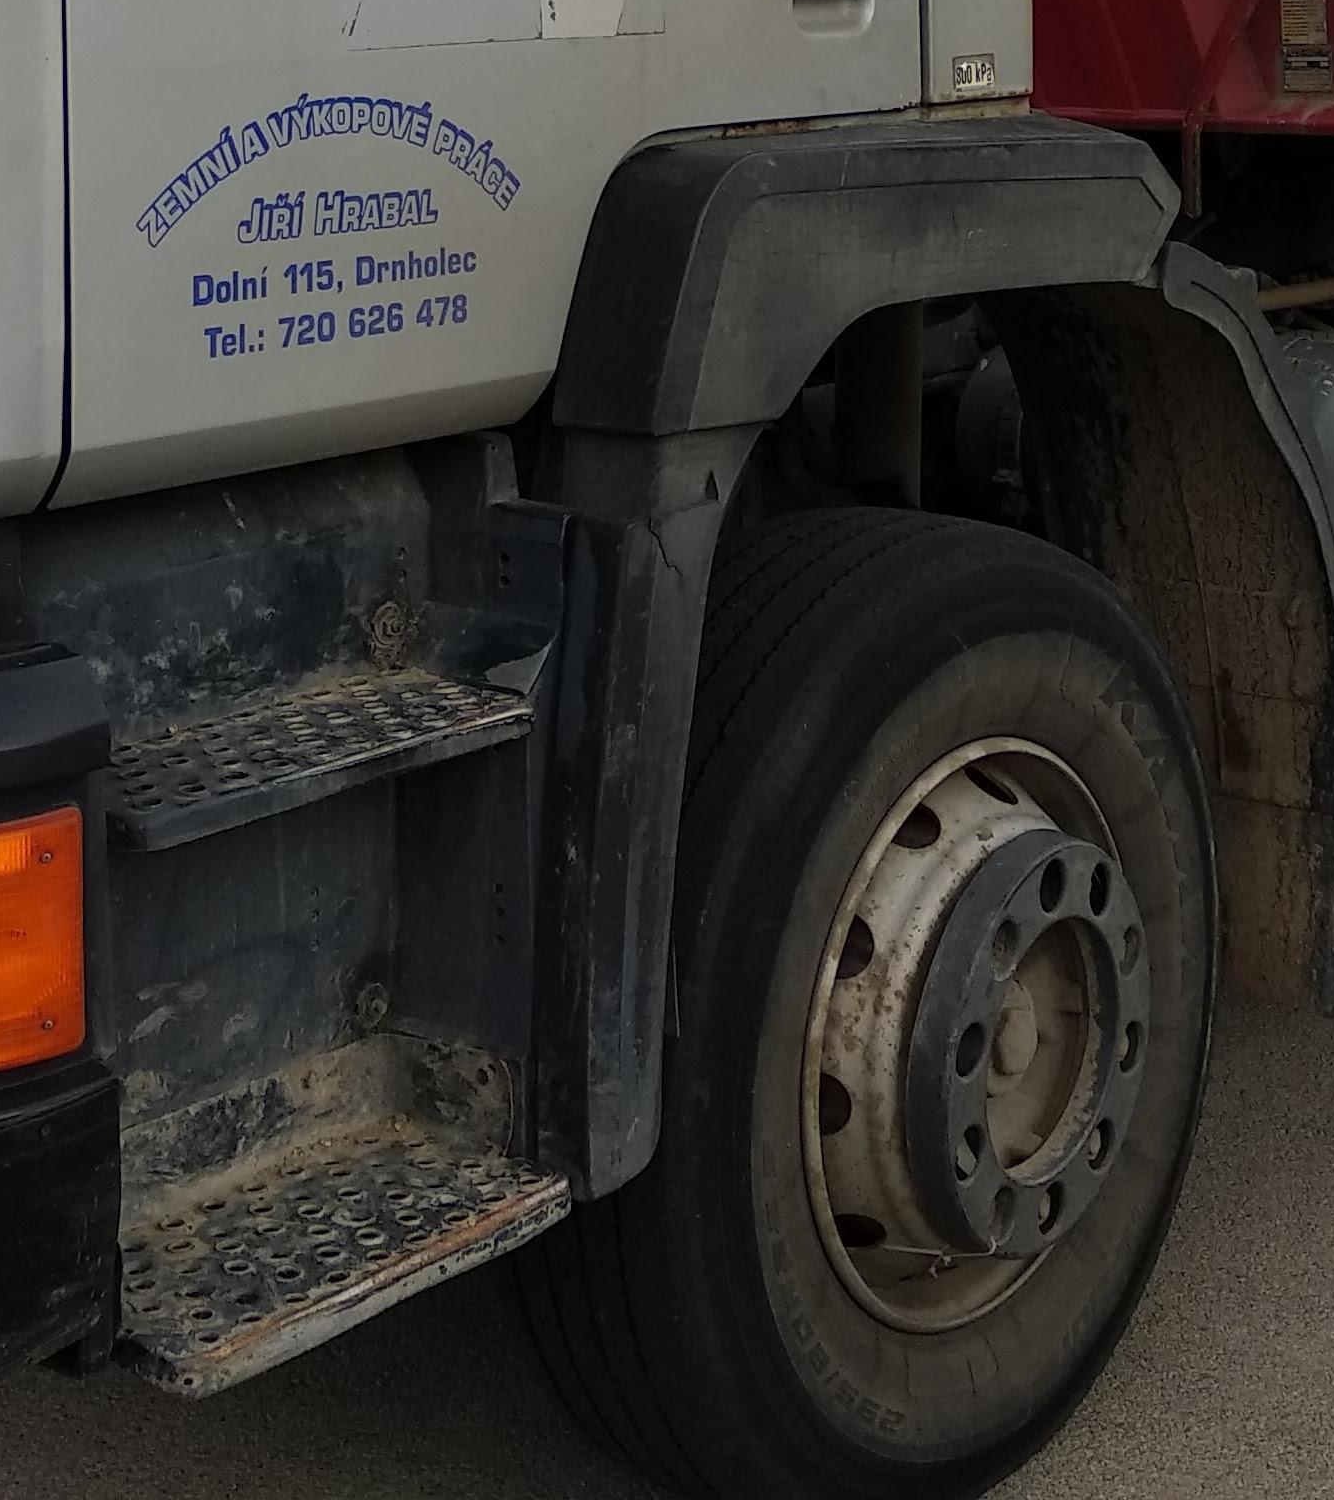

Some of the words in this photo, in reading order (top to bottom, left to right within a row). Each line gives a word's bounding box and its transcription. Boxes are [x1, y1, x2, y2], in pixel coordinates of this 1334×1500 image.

[136, 125, 242, 248] ZEMNÍ
[241, 121, 270, 165] A
[266, 92, 433, 148] VÝKOPOVÉ
[433, 118, 521, 211] PRÁCE
[192, 266, 268, 307] Dolní
[283, 259, 344, 295] 115,
[357, 247, 477, 287] Drnholec
[203, 323, 265, 359] Tel.:
[277, 311, 336, 348] 720
[349, 302, 404, 338] 626
[416, 294, 468, 328] 478
